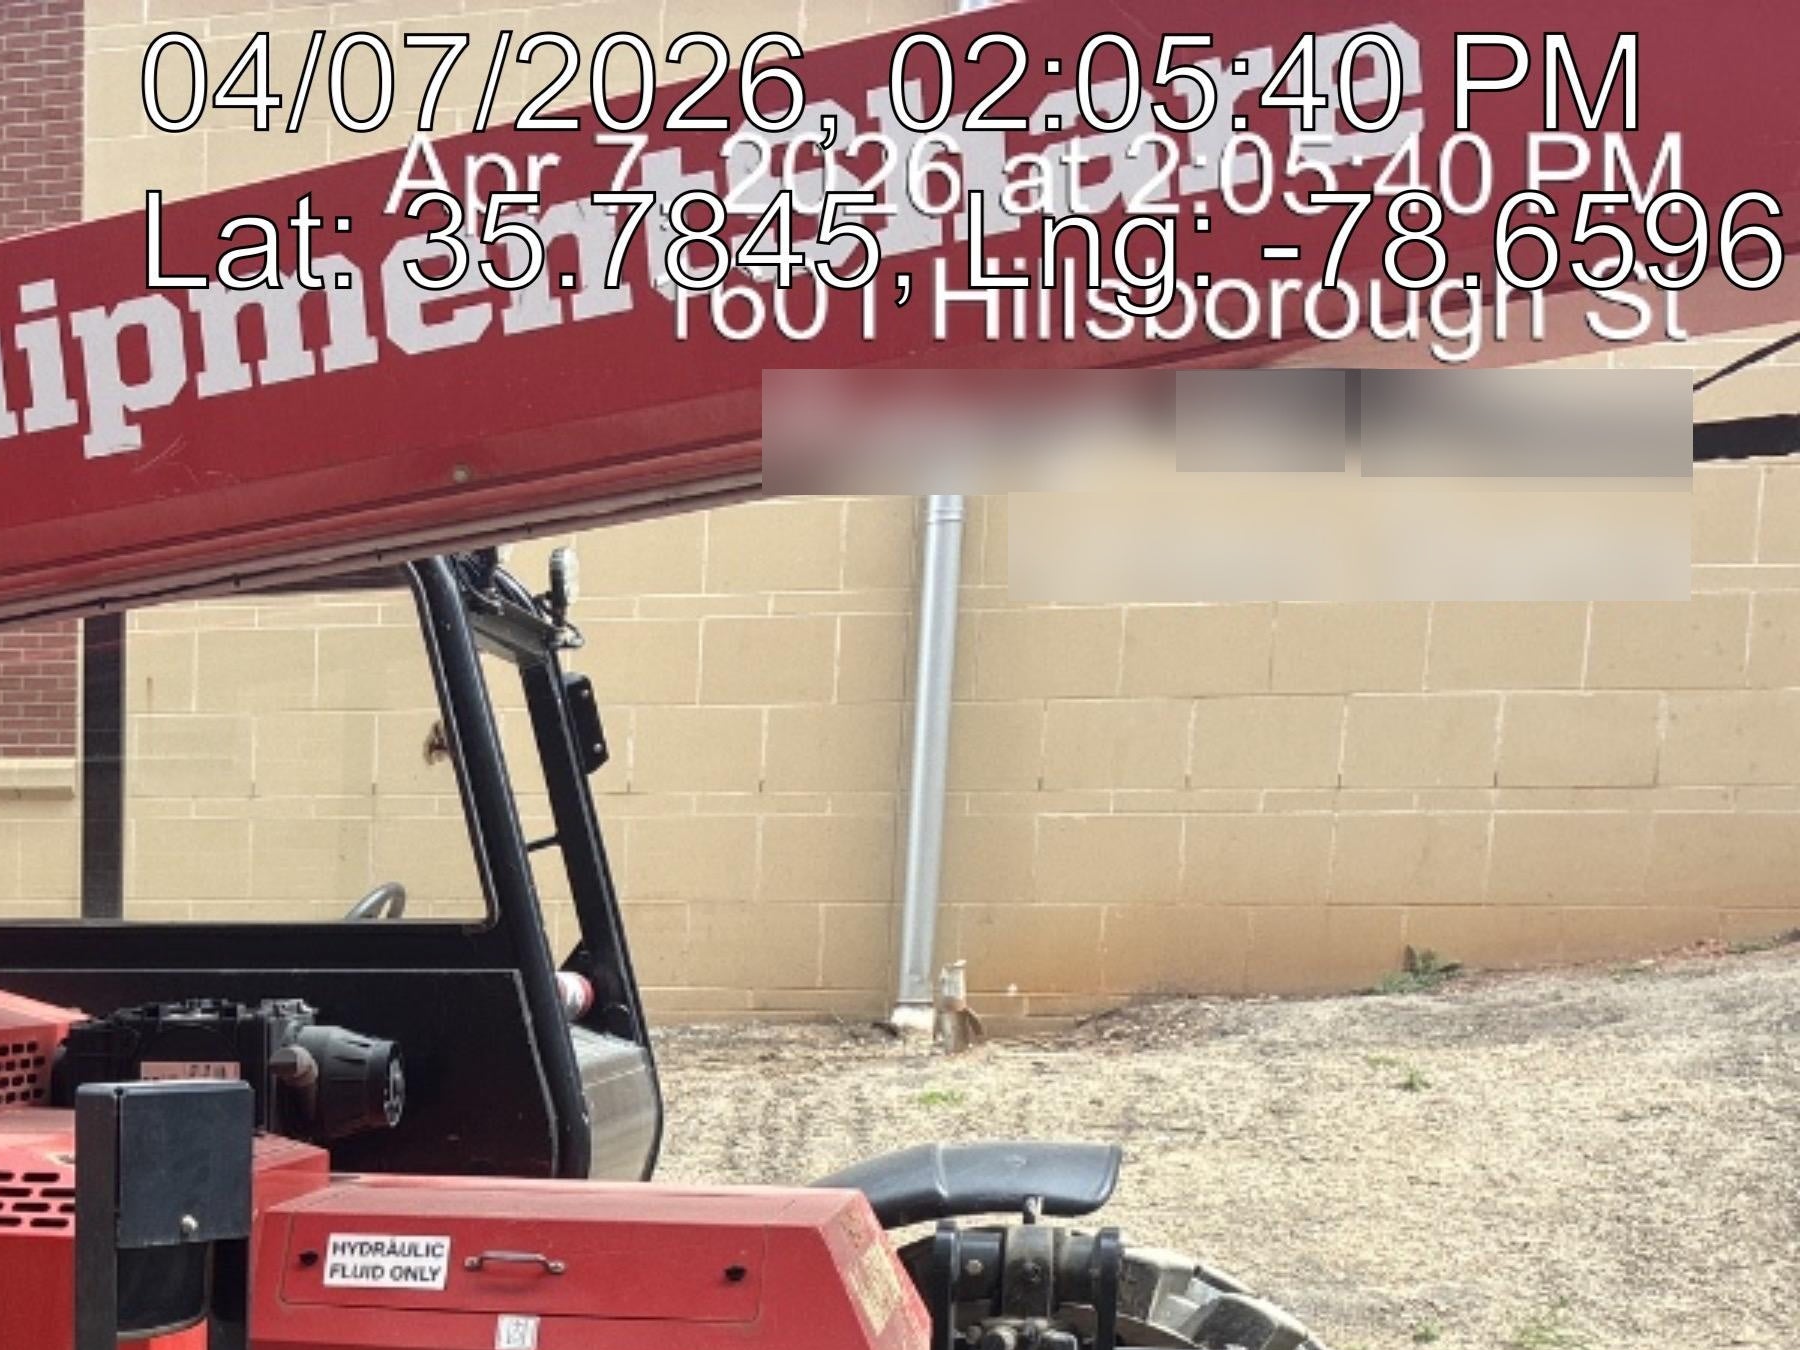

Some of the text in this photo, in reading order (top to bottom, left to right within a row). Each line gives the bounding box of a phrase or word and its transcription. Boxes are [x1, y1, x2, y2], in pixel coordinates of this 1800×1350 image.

[332, 1240, 445, 1259] HYDRAULIC
[329, 1264, 442, 1282] FLUID ONLY
